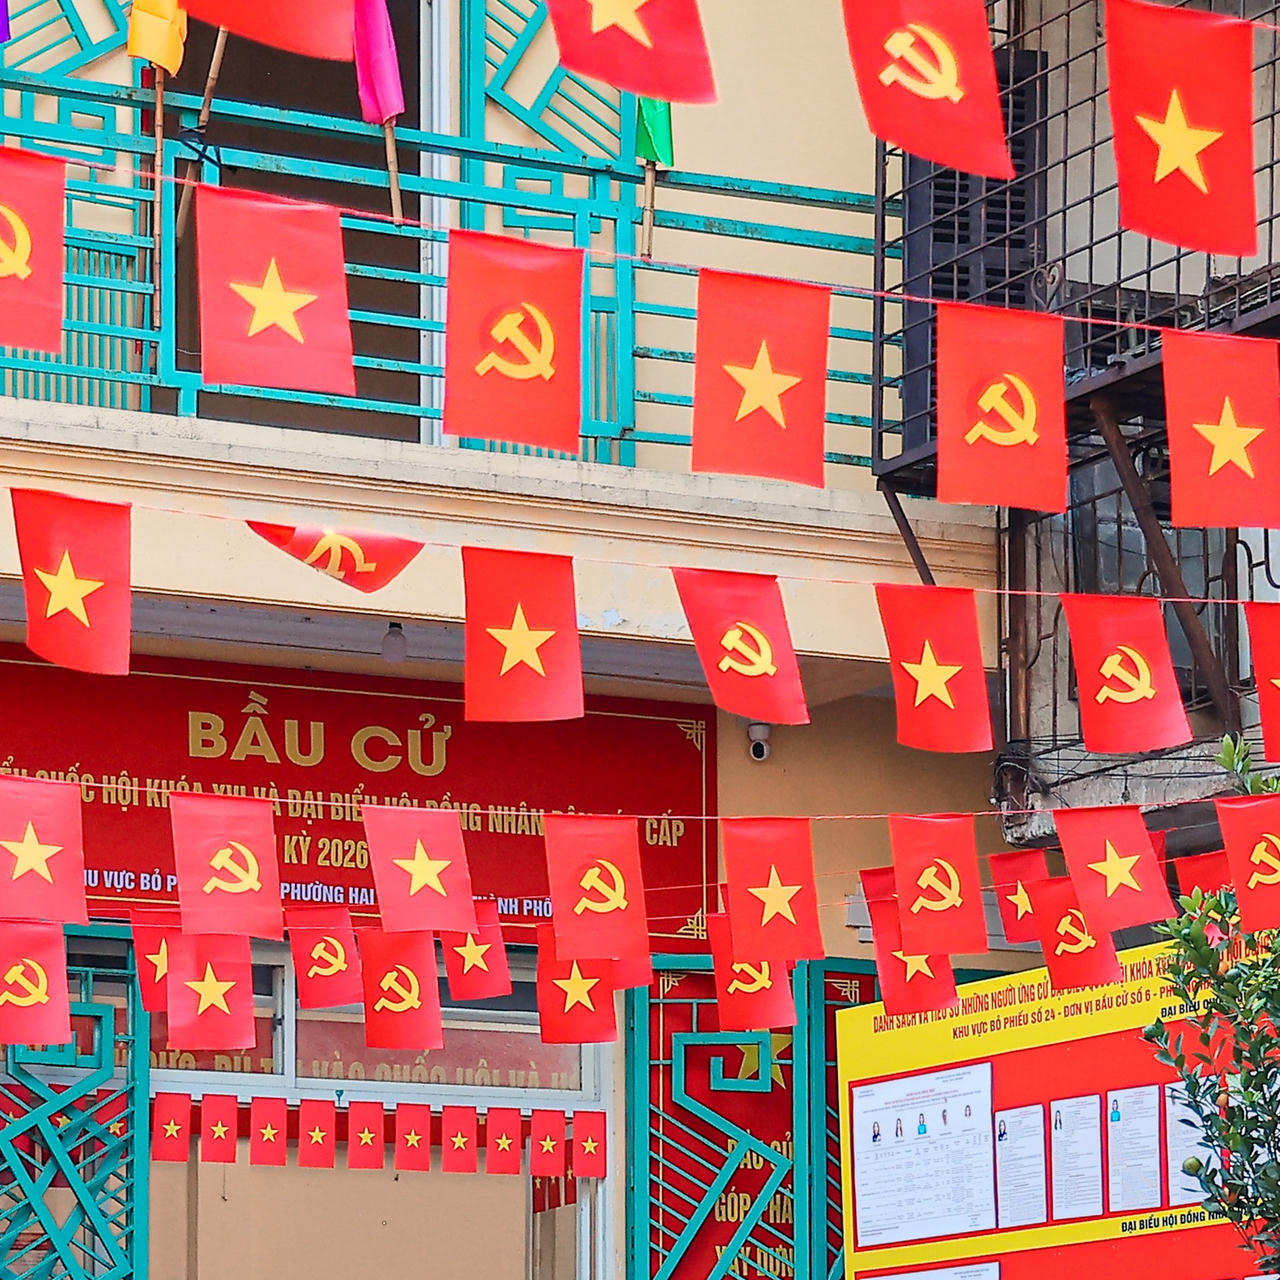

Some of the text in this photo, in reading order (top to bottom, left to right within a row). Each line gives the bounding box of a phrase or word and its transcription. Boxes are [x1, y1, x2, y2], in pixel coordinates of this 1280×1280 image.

[188, 690, 453, 777] BẦU CỬ
[102, 771, 140, 812] HỘI
[287, 789, 325, 825] ĐẠI
[488, 801, 545, 837] NHÂN
[645, 809, 686, 847] CẤP
[284, 830, 313, 865] KỲ
[103, 869, 136, 893] VỰC
[140, 868, 162, 892] BỎ
[280, 880, 345, 904] PHƯỜNG
[349, 887, 375, 906] HAI
[961, 992, 990, 1016] NHỮNG
[991, 984, 1017, 1009] NGƯỜI
[1018, 981, 1036, 1004] ỨNG
[1130, 956, 1154, 982] KHÓA
[952, 1024, 970, 1040] KHU
[971, 1021, 988, 1037] VỰC
[990, 1014, 1002, 1032] BỎ
[1003, 1010, 1029, 1029] PHIẾU
[1030, 1006, 1043, 1024] SỐ
[1044, 1008, 1056, 1023] 24
[1063, 1001, 1082, 1018] ĐƠN
[1084, 1000, 1094, 1016] VỊ
[1115, 988, 1129, 1008] CỬ
[1130, 985, 1143, 1005] SỐ
[1145, 989, 1151, 1002] 6
[1161, 1005, 1177, 1020] ĐẠI
[1121, 1220, 1137, 1234] ĐẠI
[1139, 1213, 1160, 1229] BIỂU
[1162, 1213, 1178, 1228] HỘI
